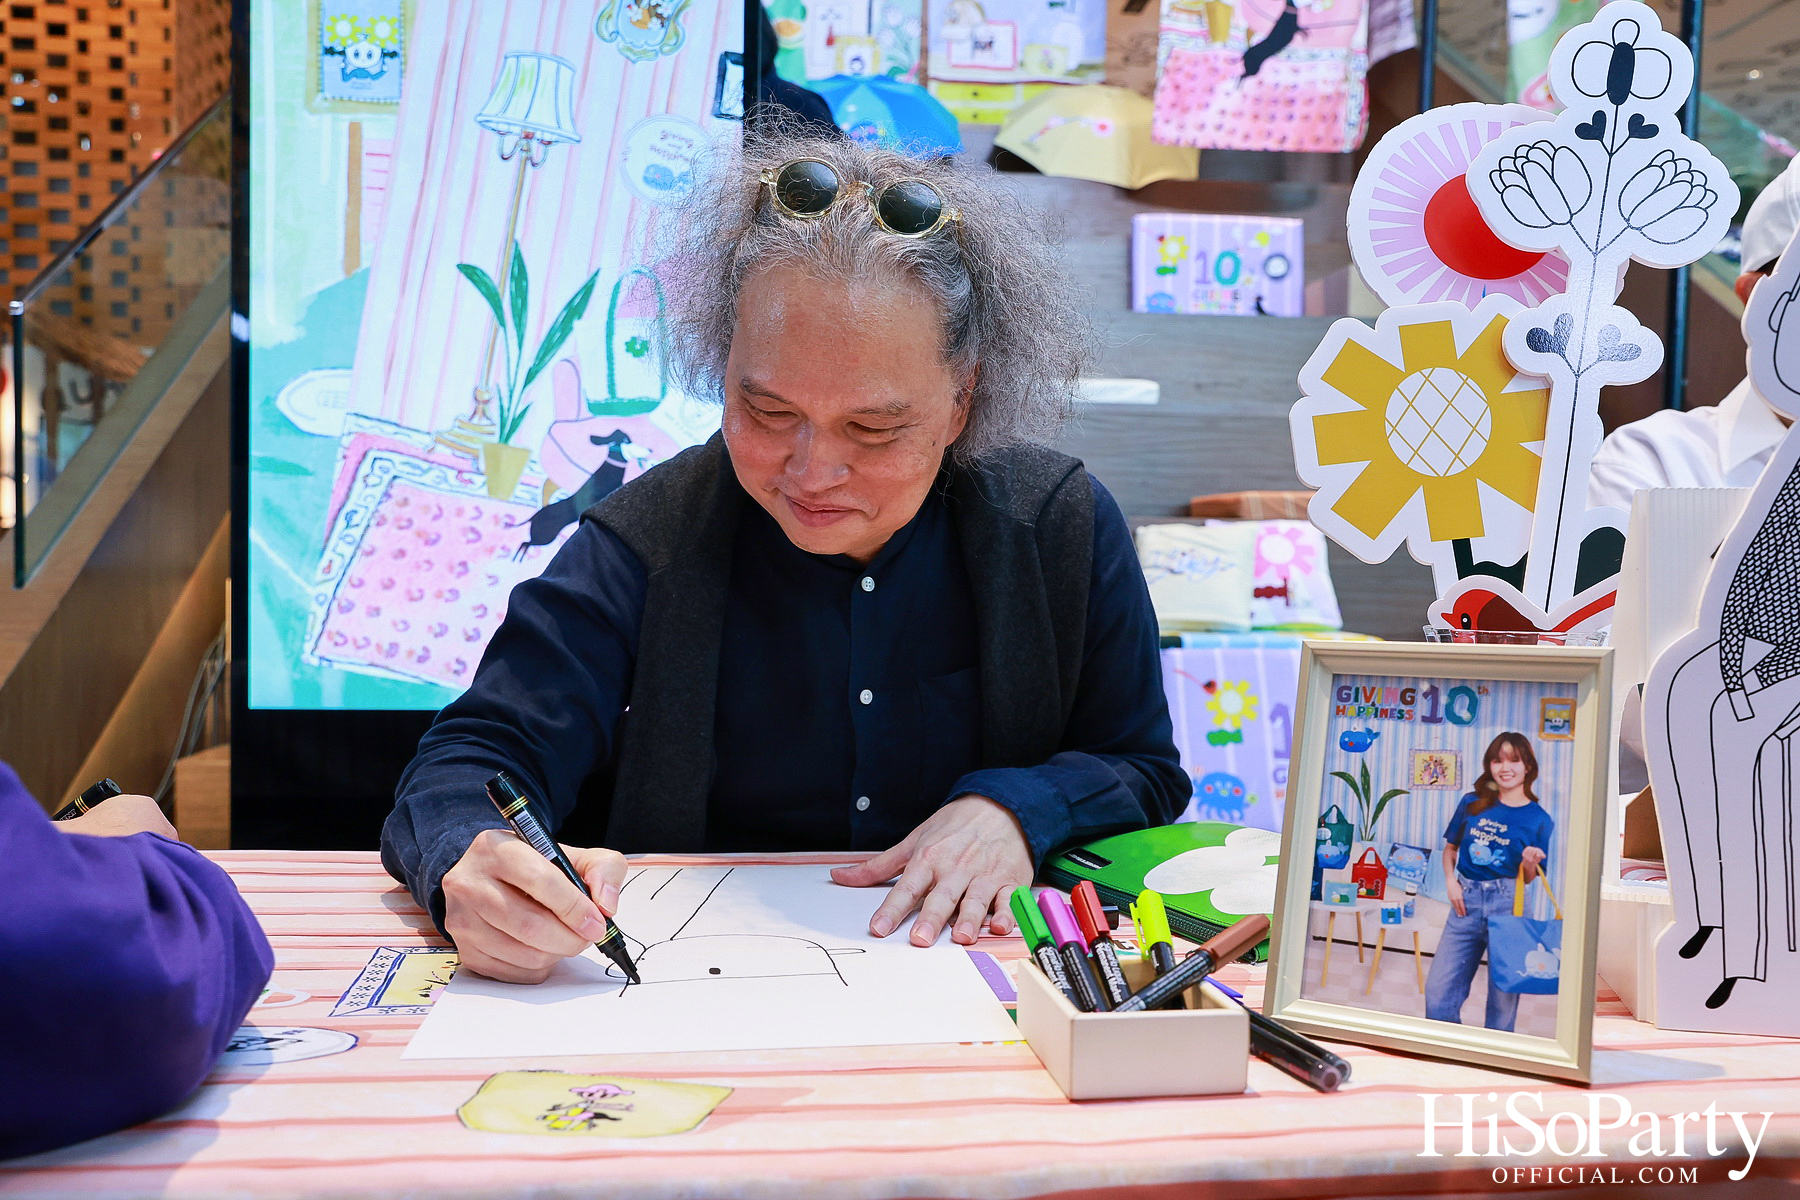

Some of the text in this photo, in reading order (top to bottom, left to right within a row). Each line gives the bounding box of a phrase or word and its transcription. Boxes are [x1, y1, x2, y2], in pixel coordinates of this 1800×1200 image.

[1195, 250, 1242, 286] 10
[1336, 685, 1417, 706] GIVING
[1336, 705, 1415, 721] HAPPINESS
